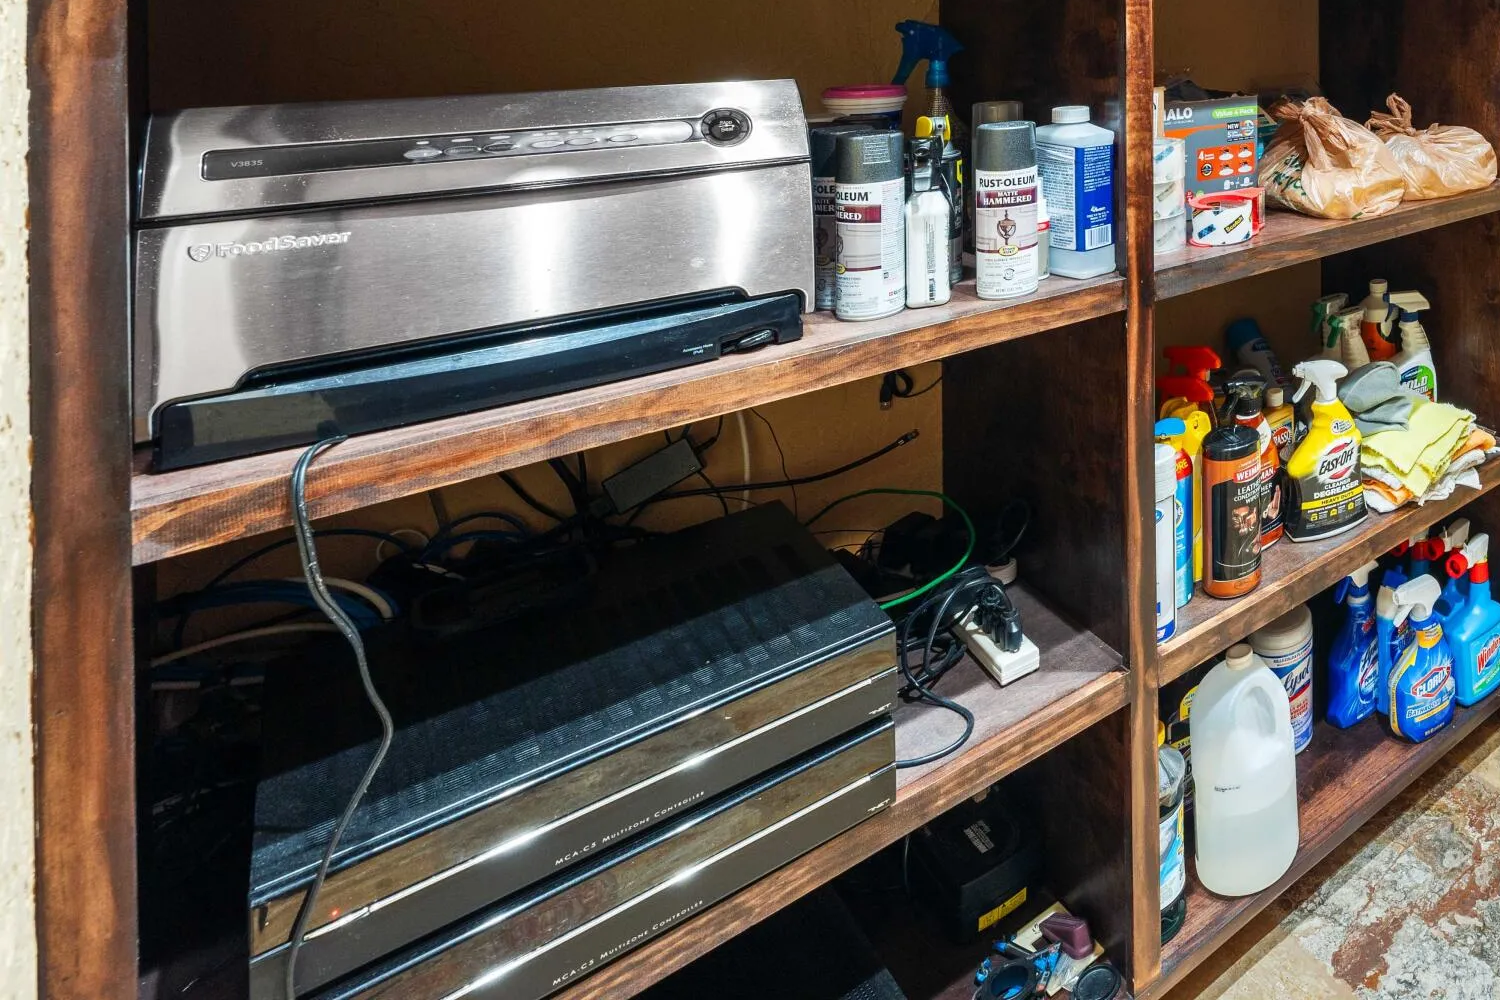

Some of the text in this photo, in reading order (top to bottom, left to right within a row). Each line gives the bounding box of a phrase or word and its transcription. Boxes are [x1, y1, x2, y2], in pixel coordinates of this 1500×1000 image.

[230, 159, 264, 168] V3835
[979, 174, 1036, 188] RUST-OLEUM
[983, 195, 1032, 206] HAMMERED
[997, 190, 1020, 198] MATTE
[1225, 215, 1244, 234] Scotch
[215, 231, 352, 258] FoodSaver
[1318, 446, 1355, 476] EASY-OFF
[1313, 480, 1360, 499] DEGREASER
[1321, 496, 1340, 505] HEAVY
[1284, 656, 1311, 696] Lysol
[1416, 669, 1450, 697] CLOROX
[602, 817, 650, 844] MULTIZONE
[654, 791, 705, 818] CONTROLLER
[600, 930, 648, 960] MULTIZONE
[652, 900, 703, 930] CONTROLLER
